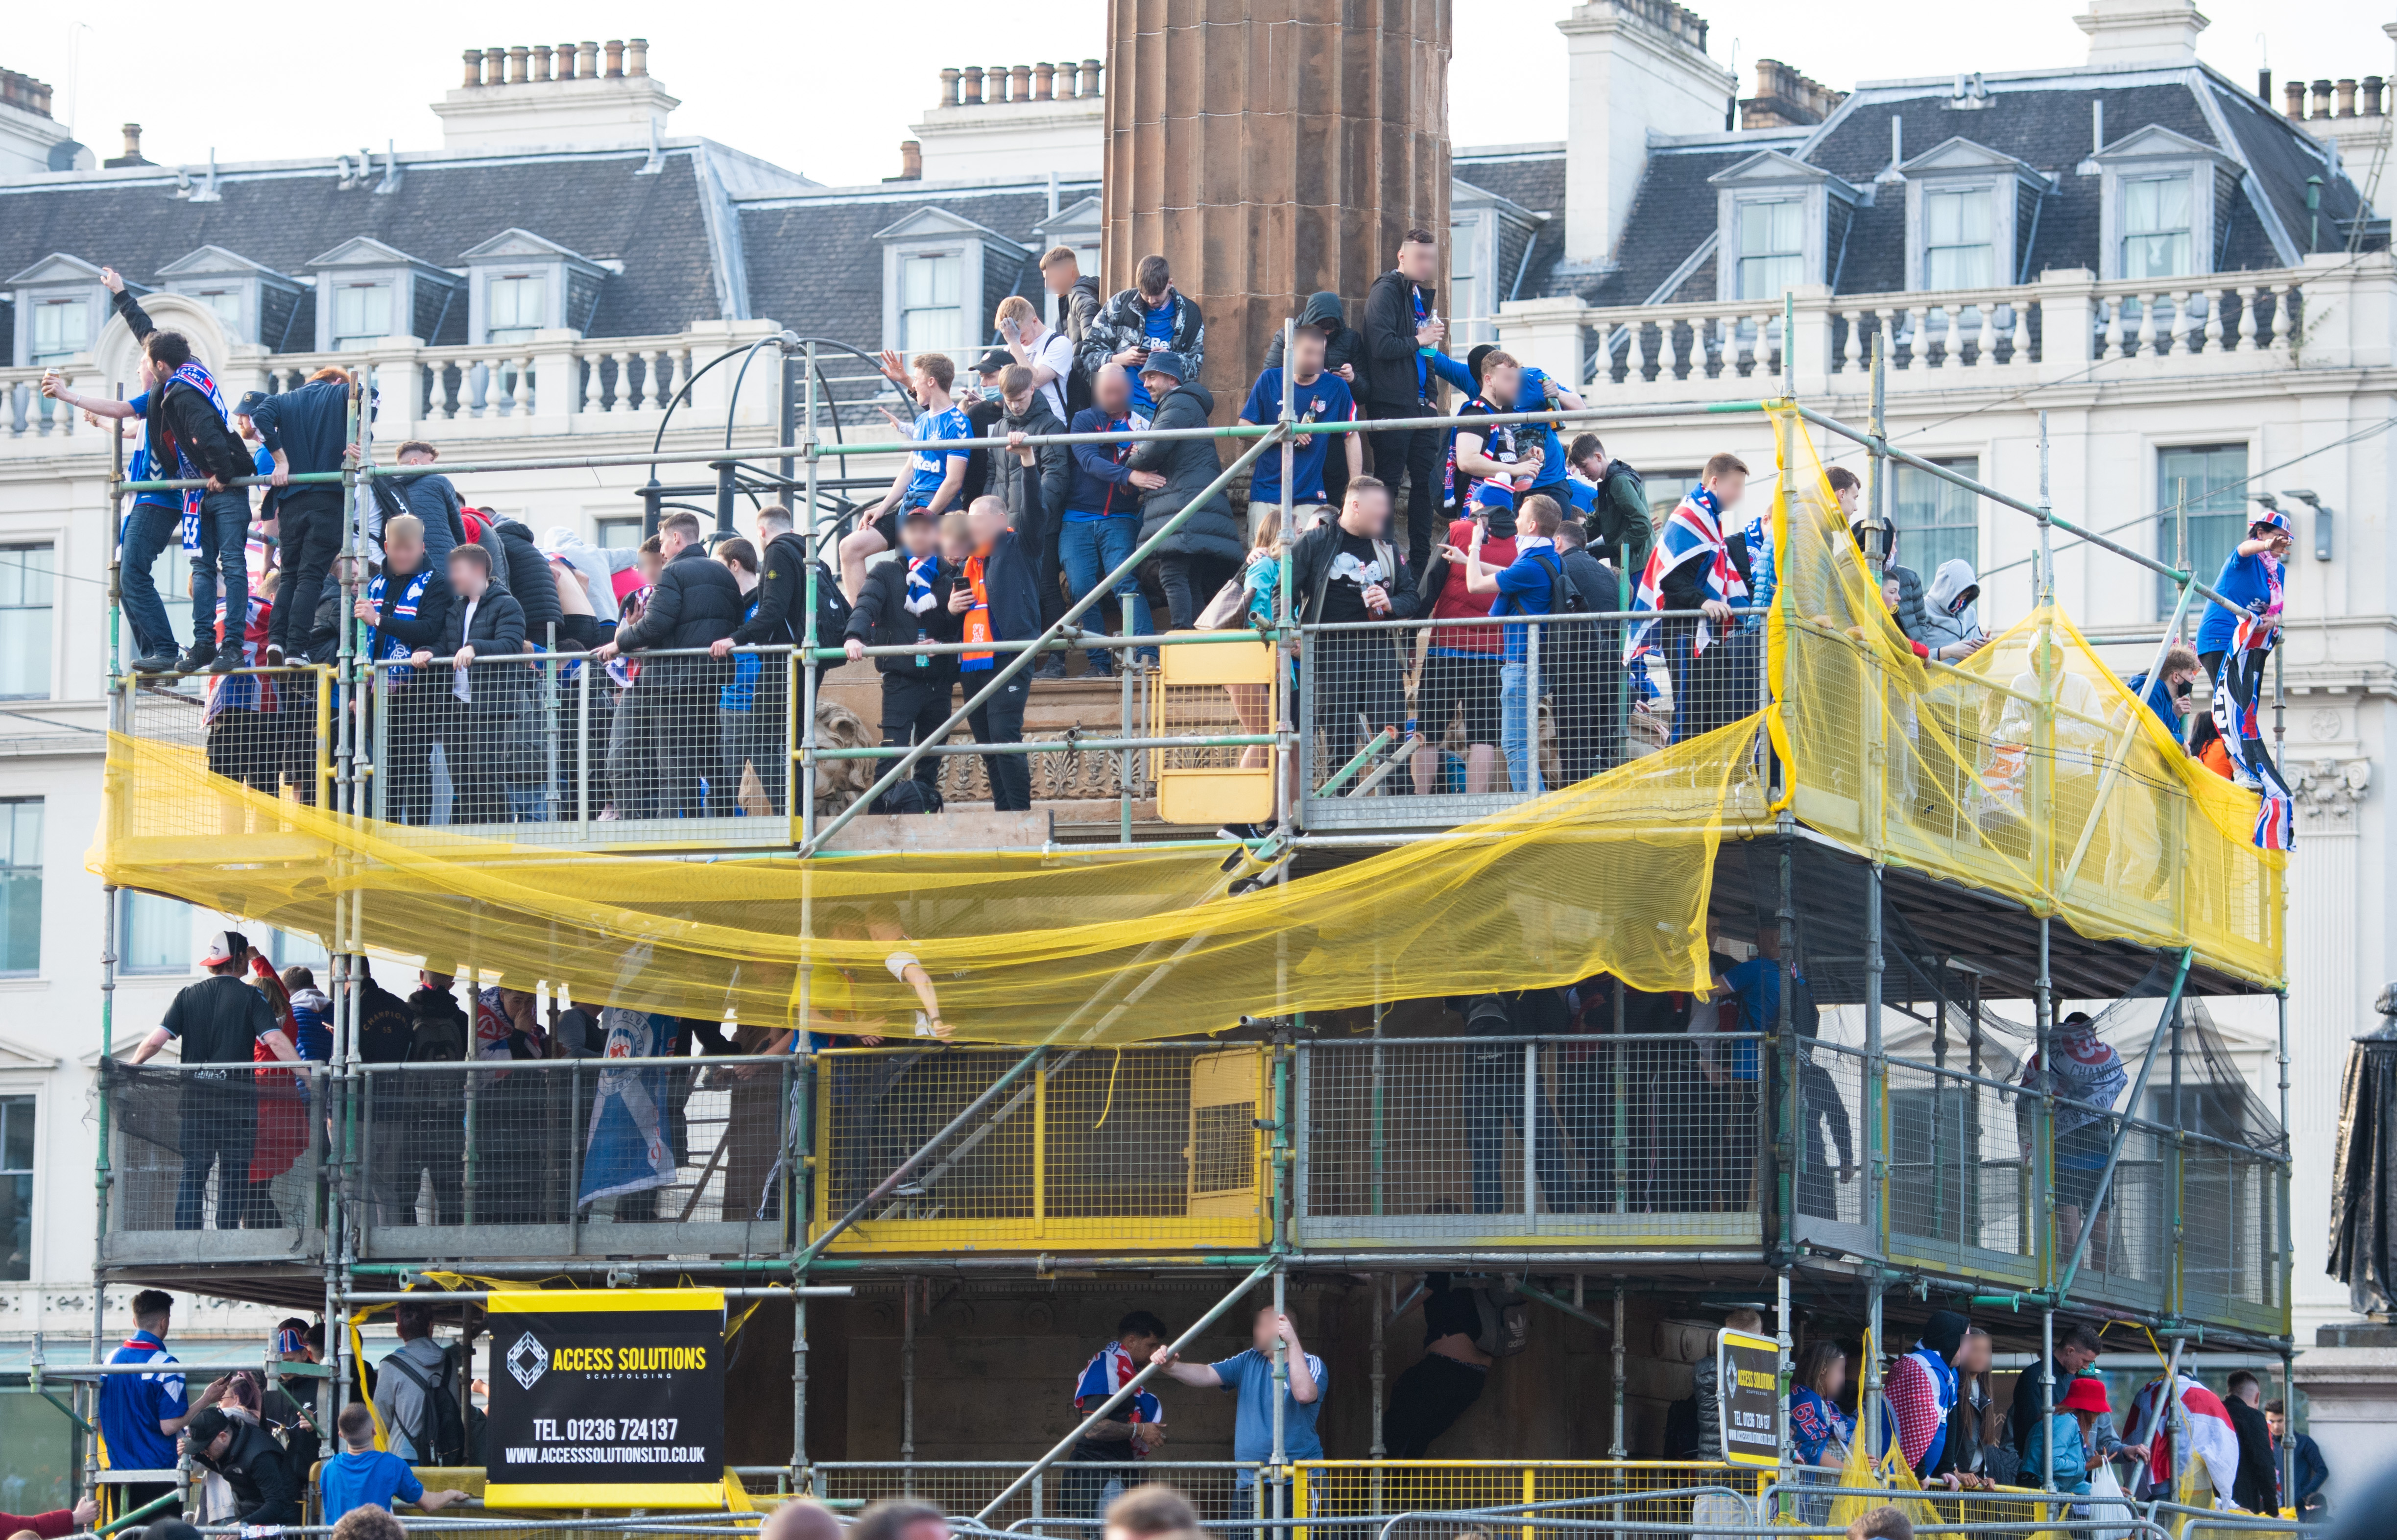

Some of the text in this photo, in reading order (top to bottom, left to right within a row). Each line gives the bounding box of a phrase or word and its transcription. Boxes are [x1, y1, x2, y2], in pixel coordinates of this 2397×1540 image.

[184, 516, 199, 544] 55
[622, 1011, 648, 1031] CLUB
[553, 1347, 706, 1371] ACCESS SOLUTIONS
[1738, 1370, 1753, 1387] ACCESS
[1754, 1372, 1775, 1391] SOLUTIONS
[534, 1420, 565, 1441] TEL.
[567, 1419, 615, 1441] 01236
[1734, 1411, 1742, 1426] TEL.
[1743, 1412, 1754, 1428] 01236
[506, 1447, 705, 1464] WWW.ACCESSSOLUTIONSLTD.CO.UK
